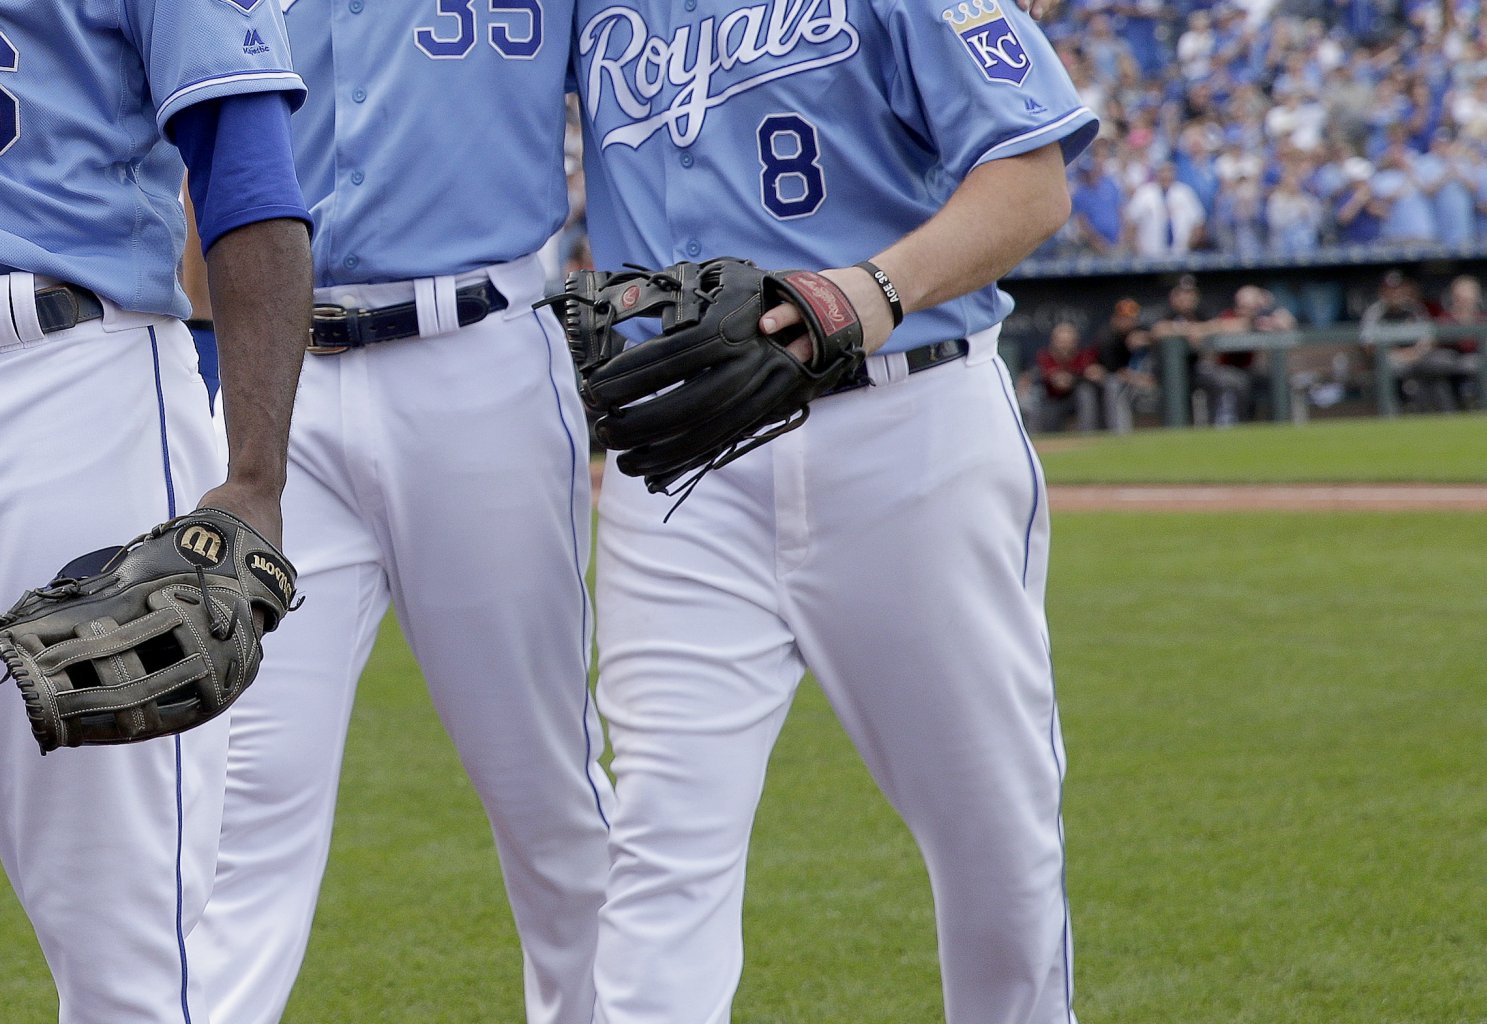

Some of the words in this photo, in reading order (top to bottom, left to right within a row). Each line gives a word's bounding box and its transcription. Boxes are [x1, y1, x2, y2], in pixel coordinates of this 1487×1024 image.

[966, 30, 1028, 69] KC
[755, 112, 827, 222] 8
[874, 270, 889, 285] 30
[883, 282, 900, 304] ACE
